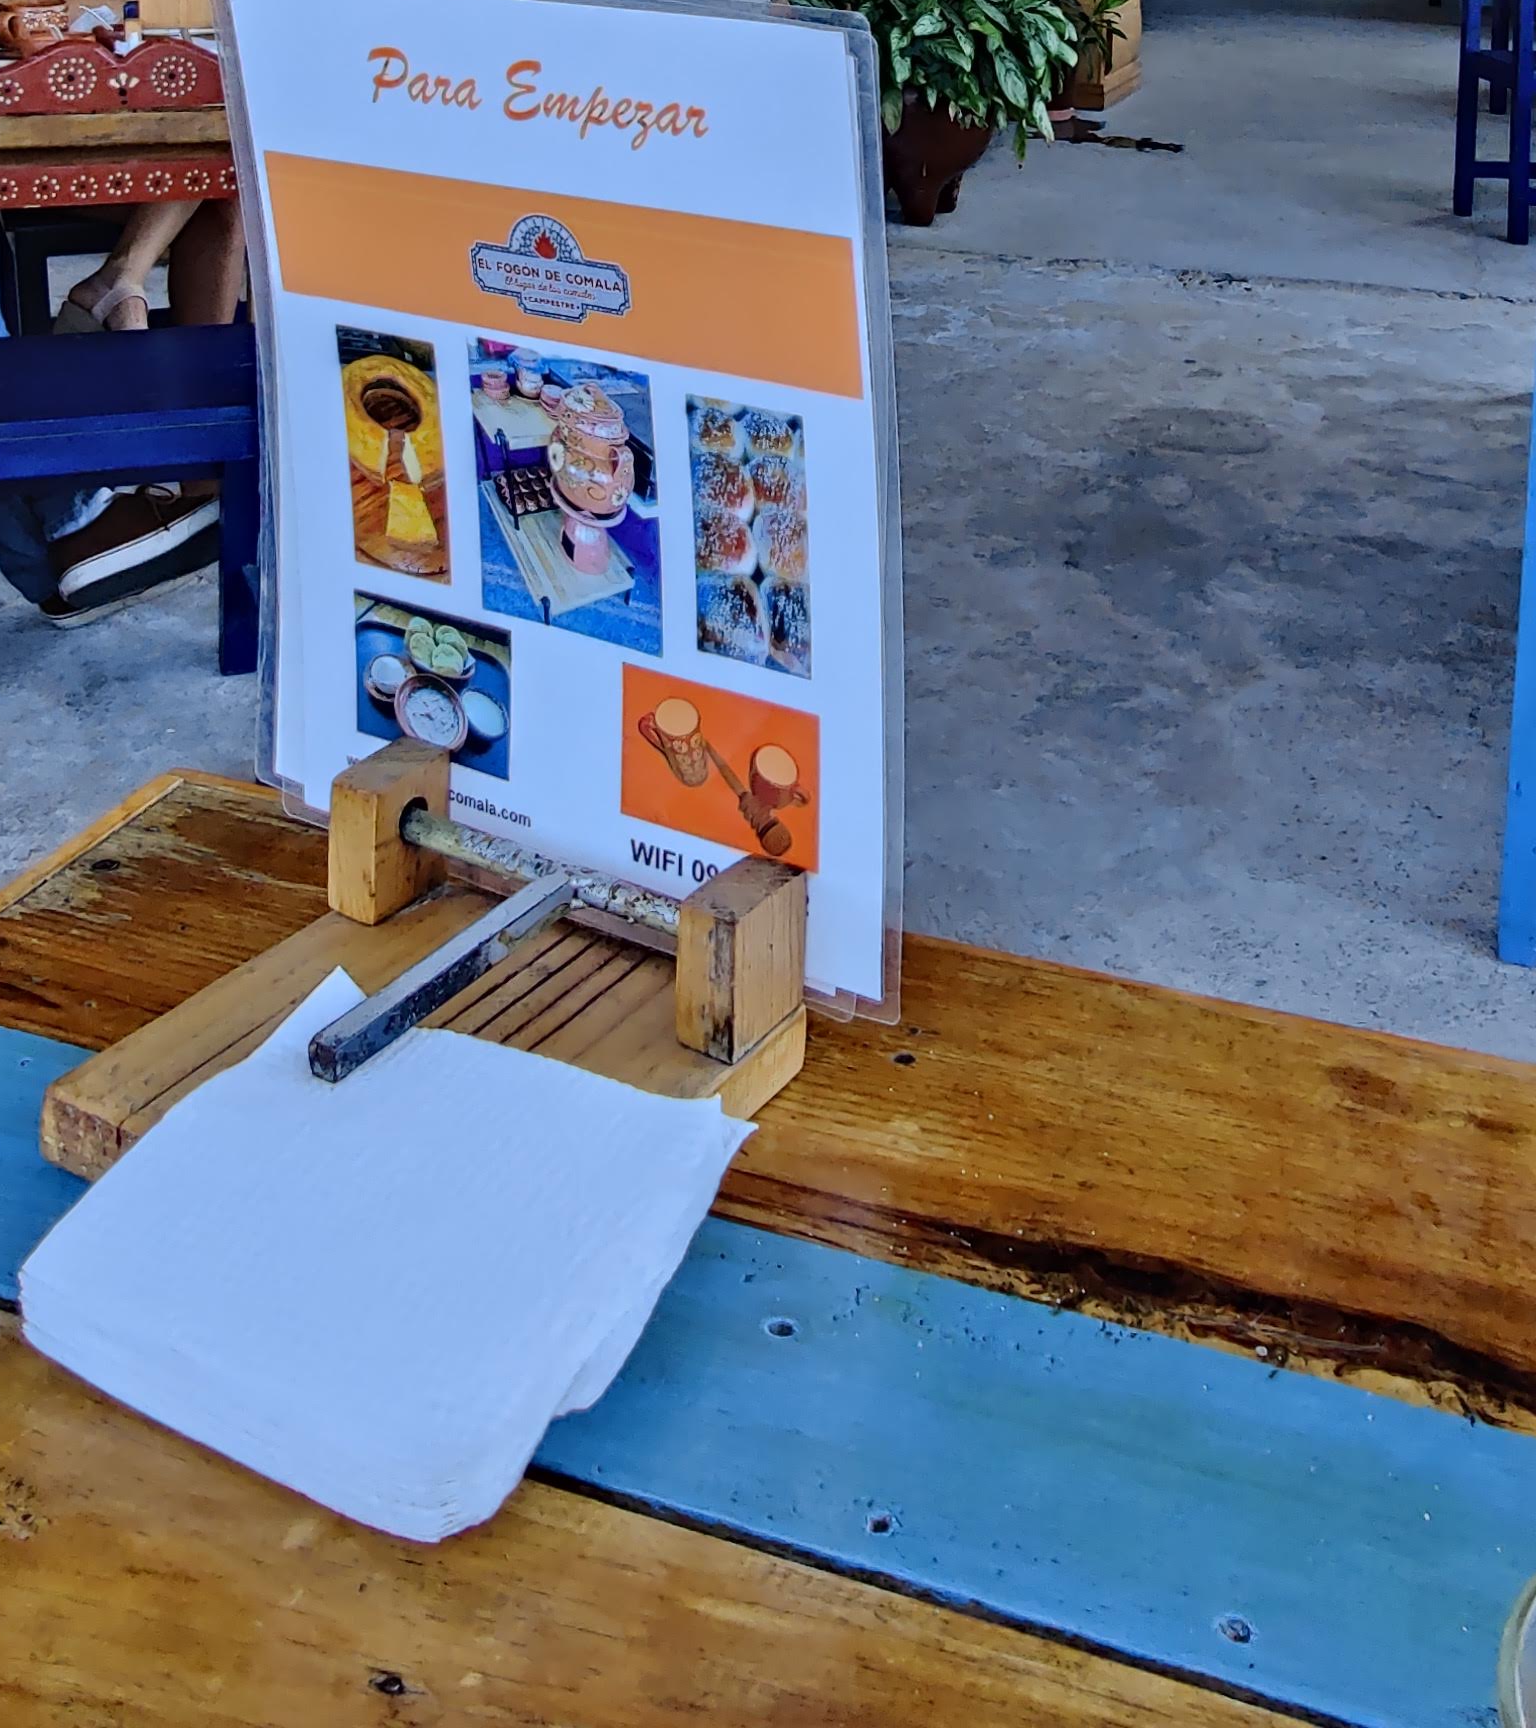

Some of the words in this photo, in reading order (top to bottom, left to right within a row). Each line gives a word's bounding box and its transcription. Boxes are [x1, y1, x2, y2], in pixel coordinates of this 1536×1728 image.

[367, 46, 482, 111] Para
[503, 59, 709, 151] Empezar
[477, 258, 492, 271] EL
[496, 262, 540, 278] FOGÓN
[545, 269, 562, 282] DE
[565, 272, 622, 293] COMALA
[528, 296, 575, 310] CAMPESTRE
[630, 838, 683, 877] WIFI
